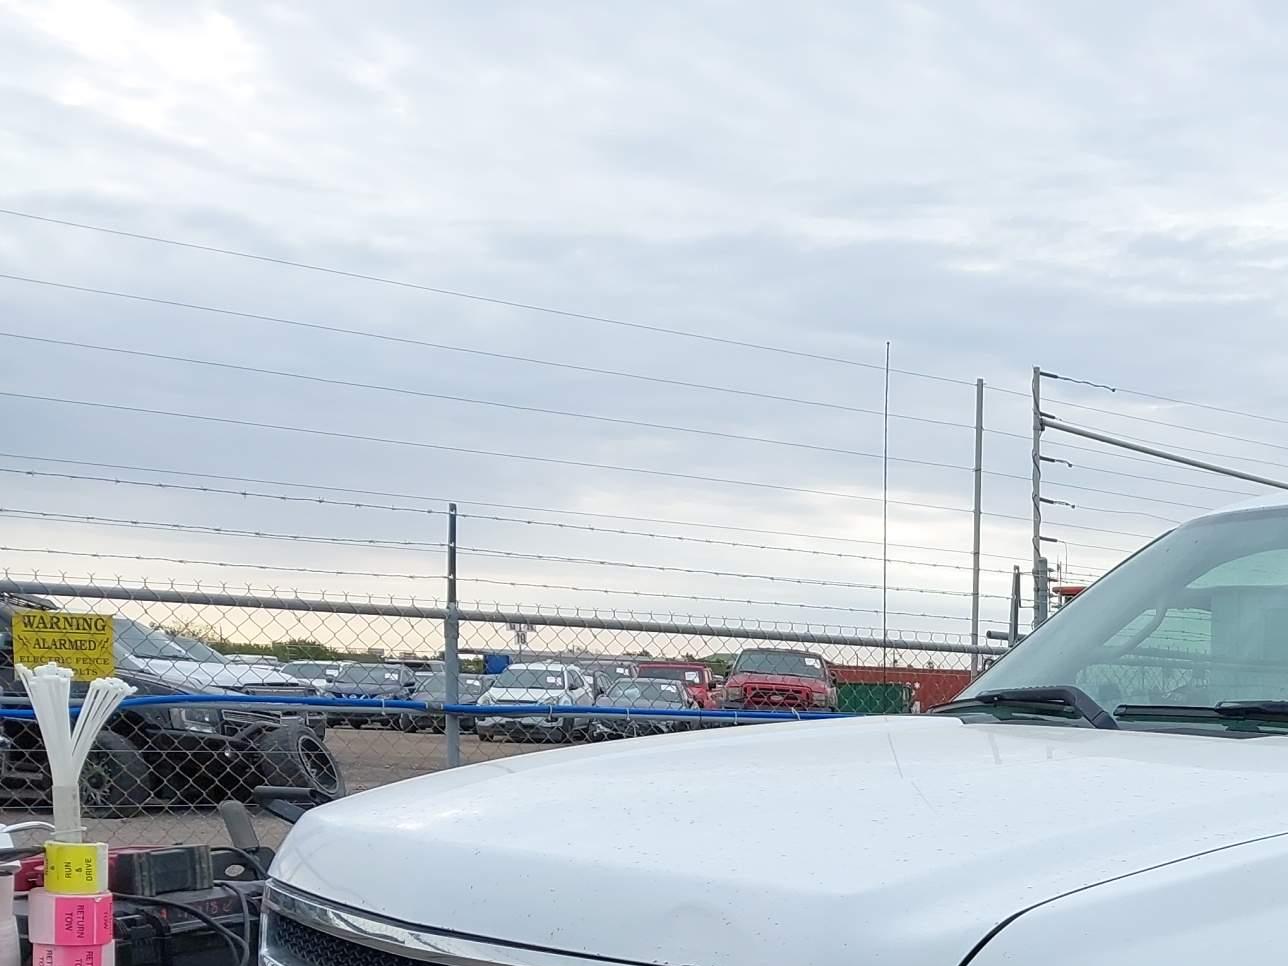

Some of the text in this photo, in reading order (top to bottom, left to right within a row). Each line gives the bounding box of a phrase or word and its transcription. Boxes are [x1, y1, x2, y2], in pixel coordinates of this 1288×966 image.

[22, 615, 106, 632] WARNING
[33, 638, 97, 651] ALARMED
[19, 655, 110, 665] ELECTRIC FENCE
[64, 861, 72, 879] RUN
[65, 912, 73, 931] TOW
[77, 905, 85, 939] RETURN
